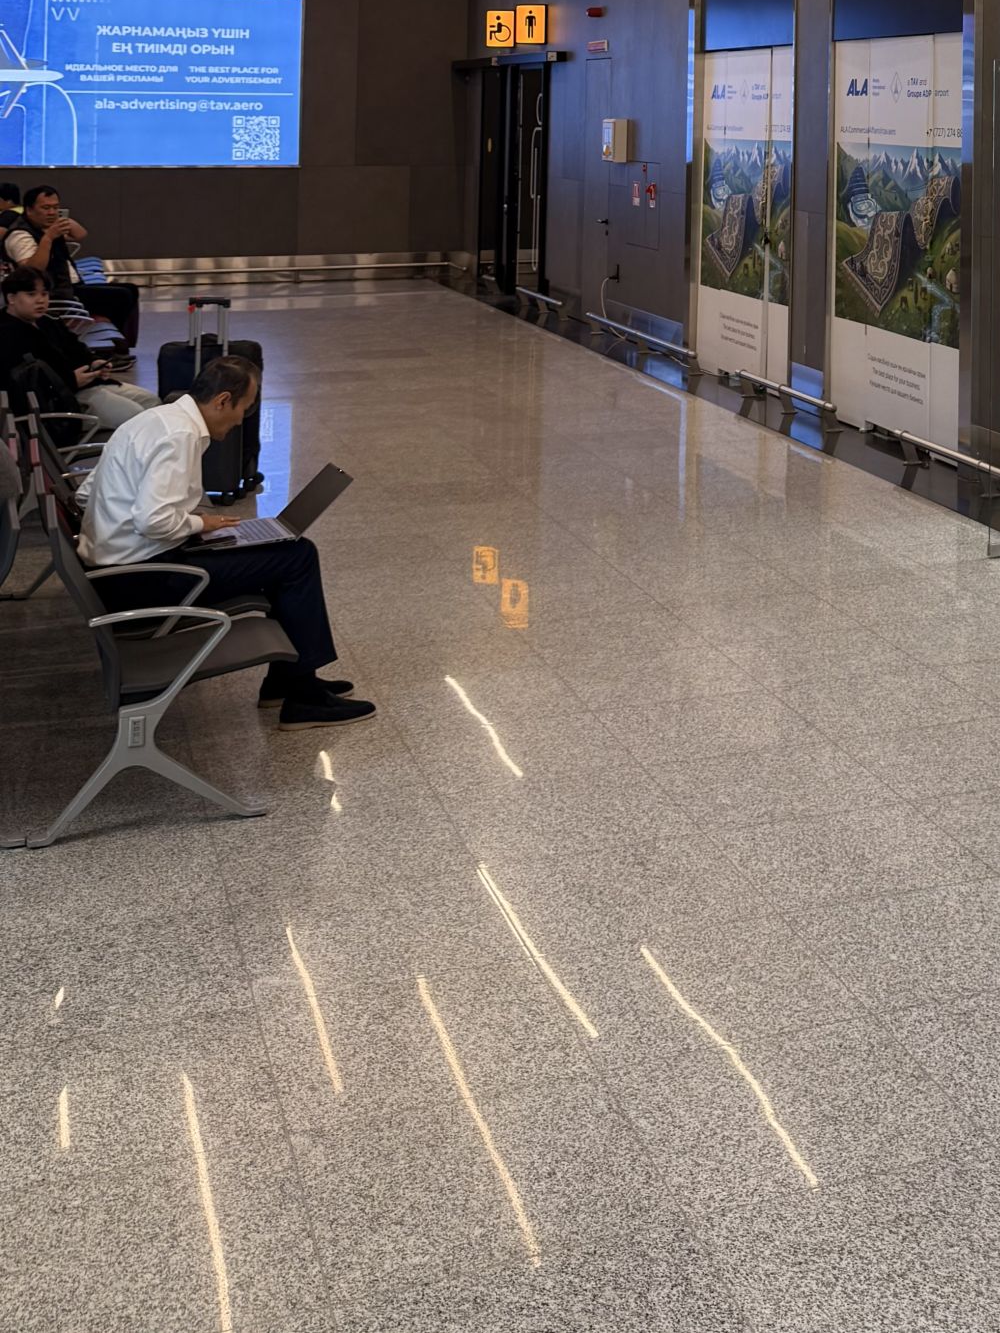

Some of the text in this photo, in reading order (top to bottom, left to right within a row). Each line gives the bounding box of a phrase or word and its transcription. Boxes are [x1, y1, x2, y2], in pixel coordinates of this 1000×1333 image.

[96, 25, 209, 40] ЖАРНАМАҢЫЗ
[112, 42, 235, 56] ЕҢ ТИІМДІ ОРЫН
[65, 64, 178, 73] ИДЕАЛЬНОЕ МЕСТО ДЛЯ
[190, 66, 279, 75] THE BEST PLACE FOR
[80, 73, 164, 83] ВАШЕЙ РЕКЛАМЫ
[185, 76, 283, 85] YOUR ADVERTISEMENT
[846, 78, 868, 97] ALA
[95, 99, 263, 112] ala-advertising@tav.aero
